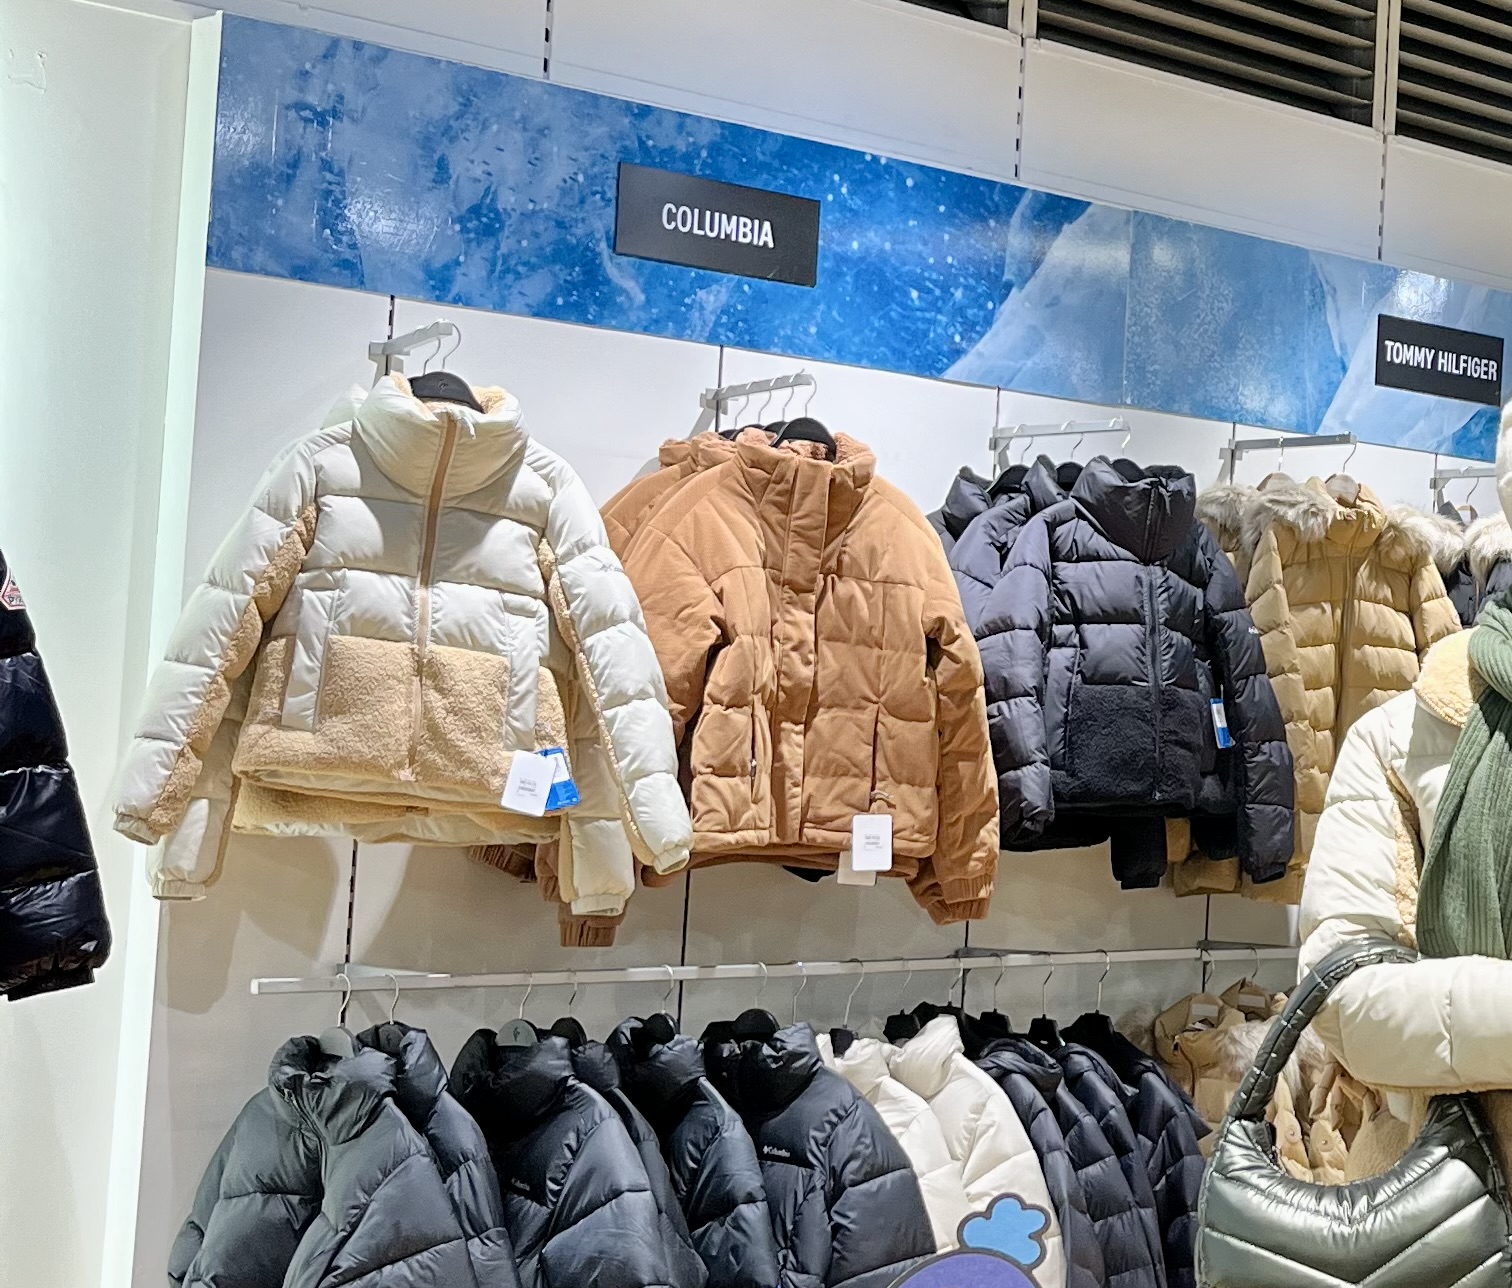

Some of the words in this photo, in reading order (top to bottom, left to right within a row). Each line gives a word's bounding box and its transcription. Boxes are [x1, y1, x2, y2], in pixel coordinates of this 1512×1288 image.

[661, 202, 775, 249] COLUMBIA
[1384, 339, 1436, 370] TOMMY
[1437, 350, 1498, 382] HILFIGER
